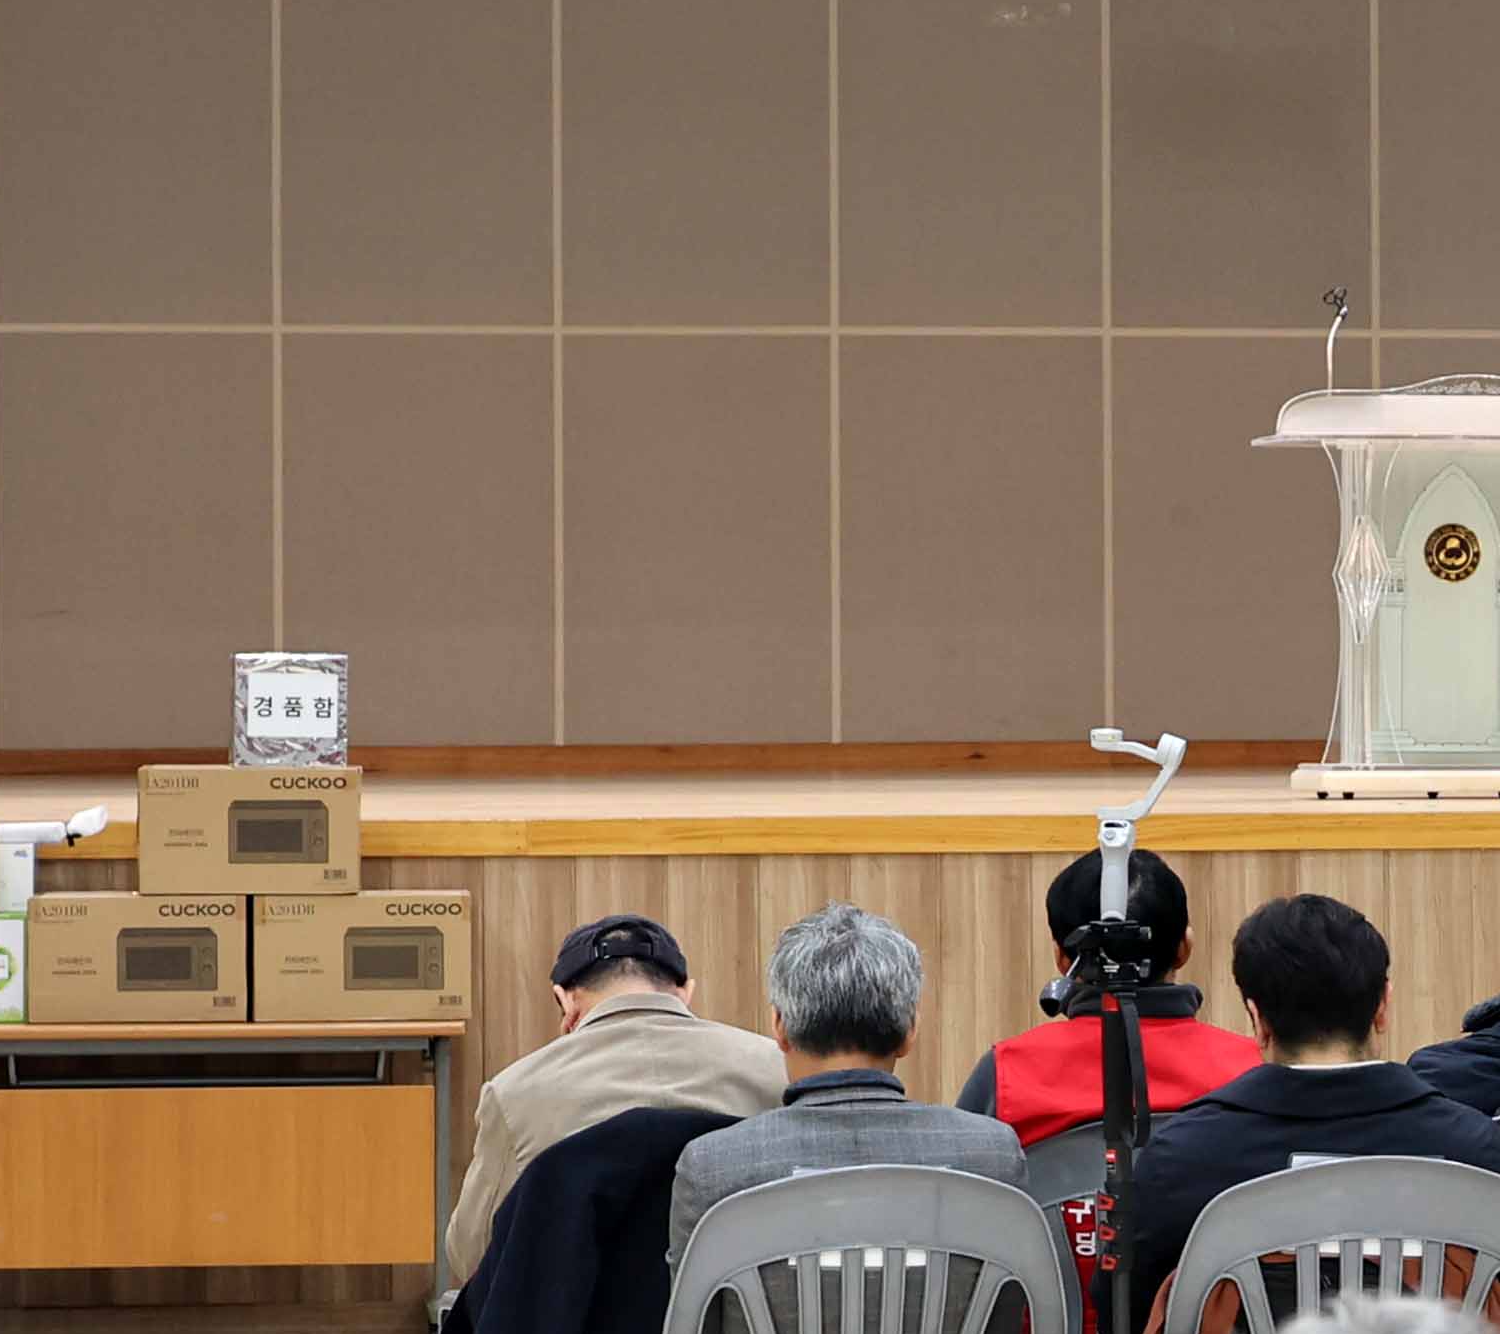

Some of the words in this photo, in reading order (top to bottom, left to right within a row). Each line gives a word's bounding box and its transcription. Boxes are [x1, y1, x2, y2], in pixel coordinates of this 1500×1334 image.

[253, 696, 335, 719] 경품함
[269, 776, 347, 790] CUCKOO
[158, 903, 236, 917] CUCKOO
[385, 903, 463, 916] CUCKOO
